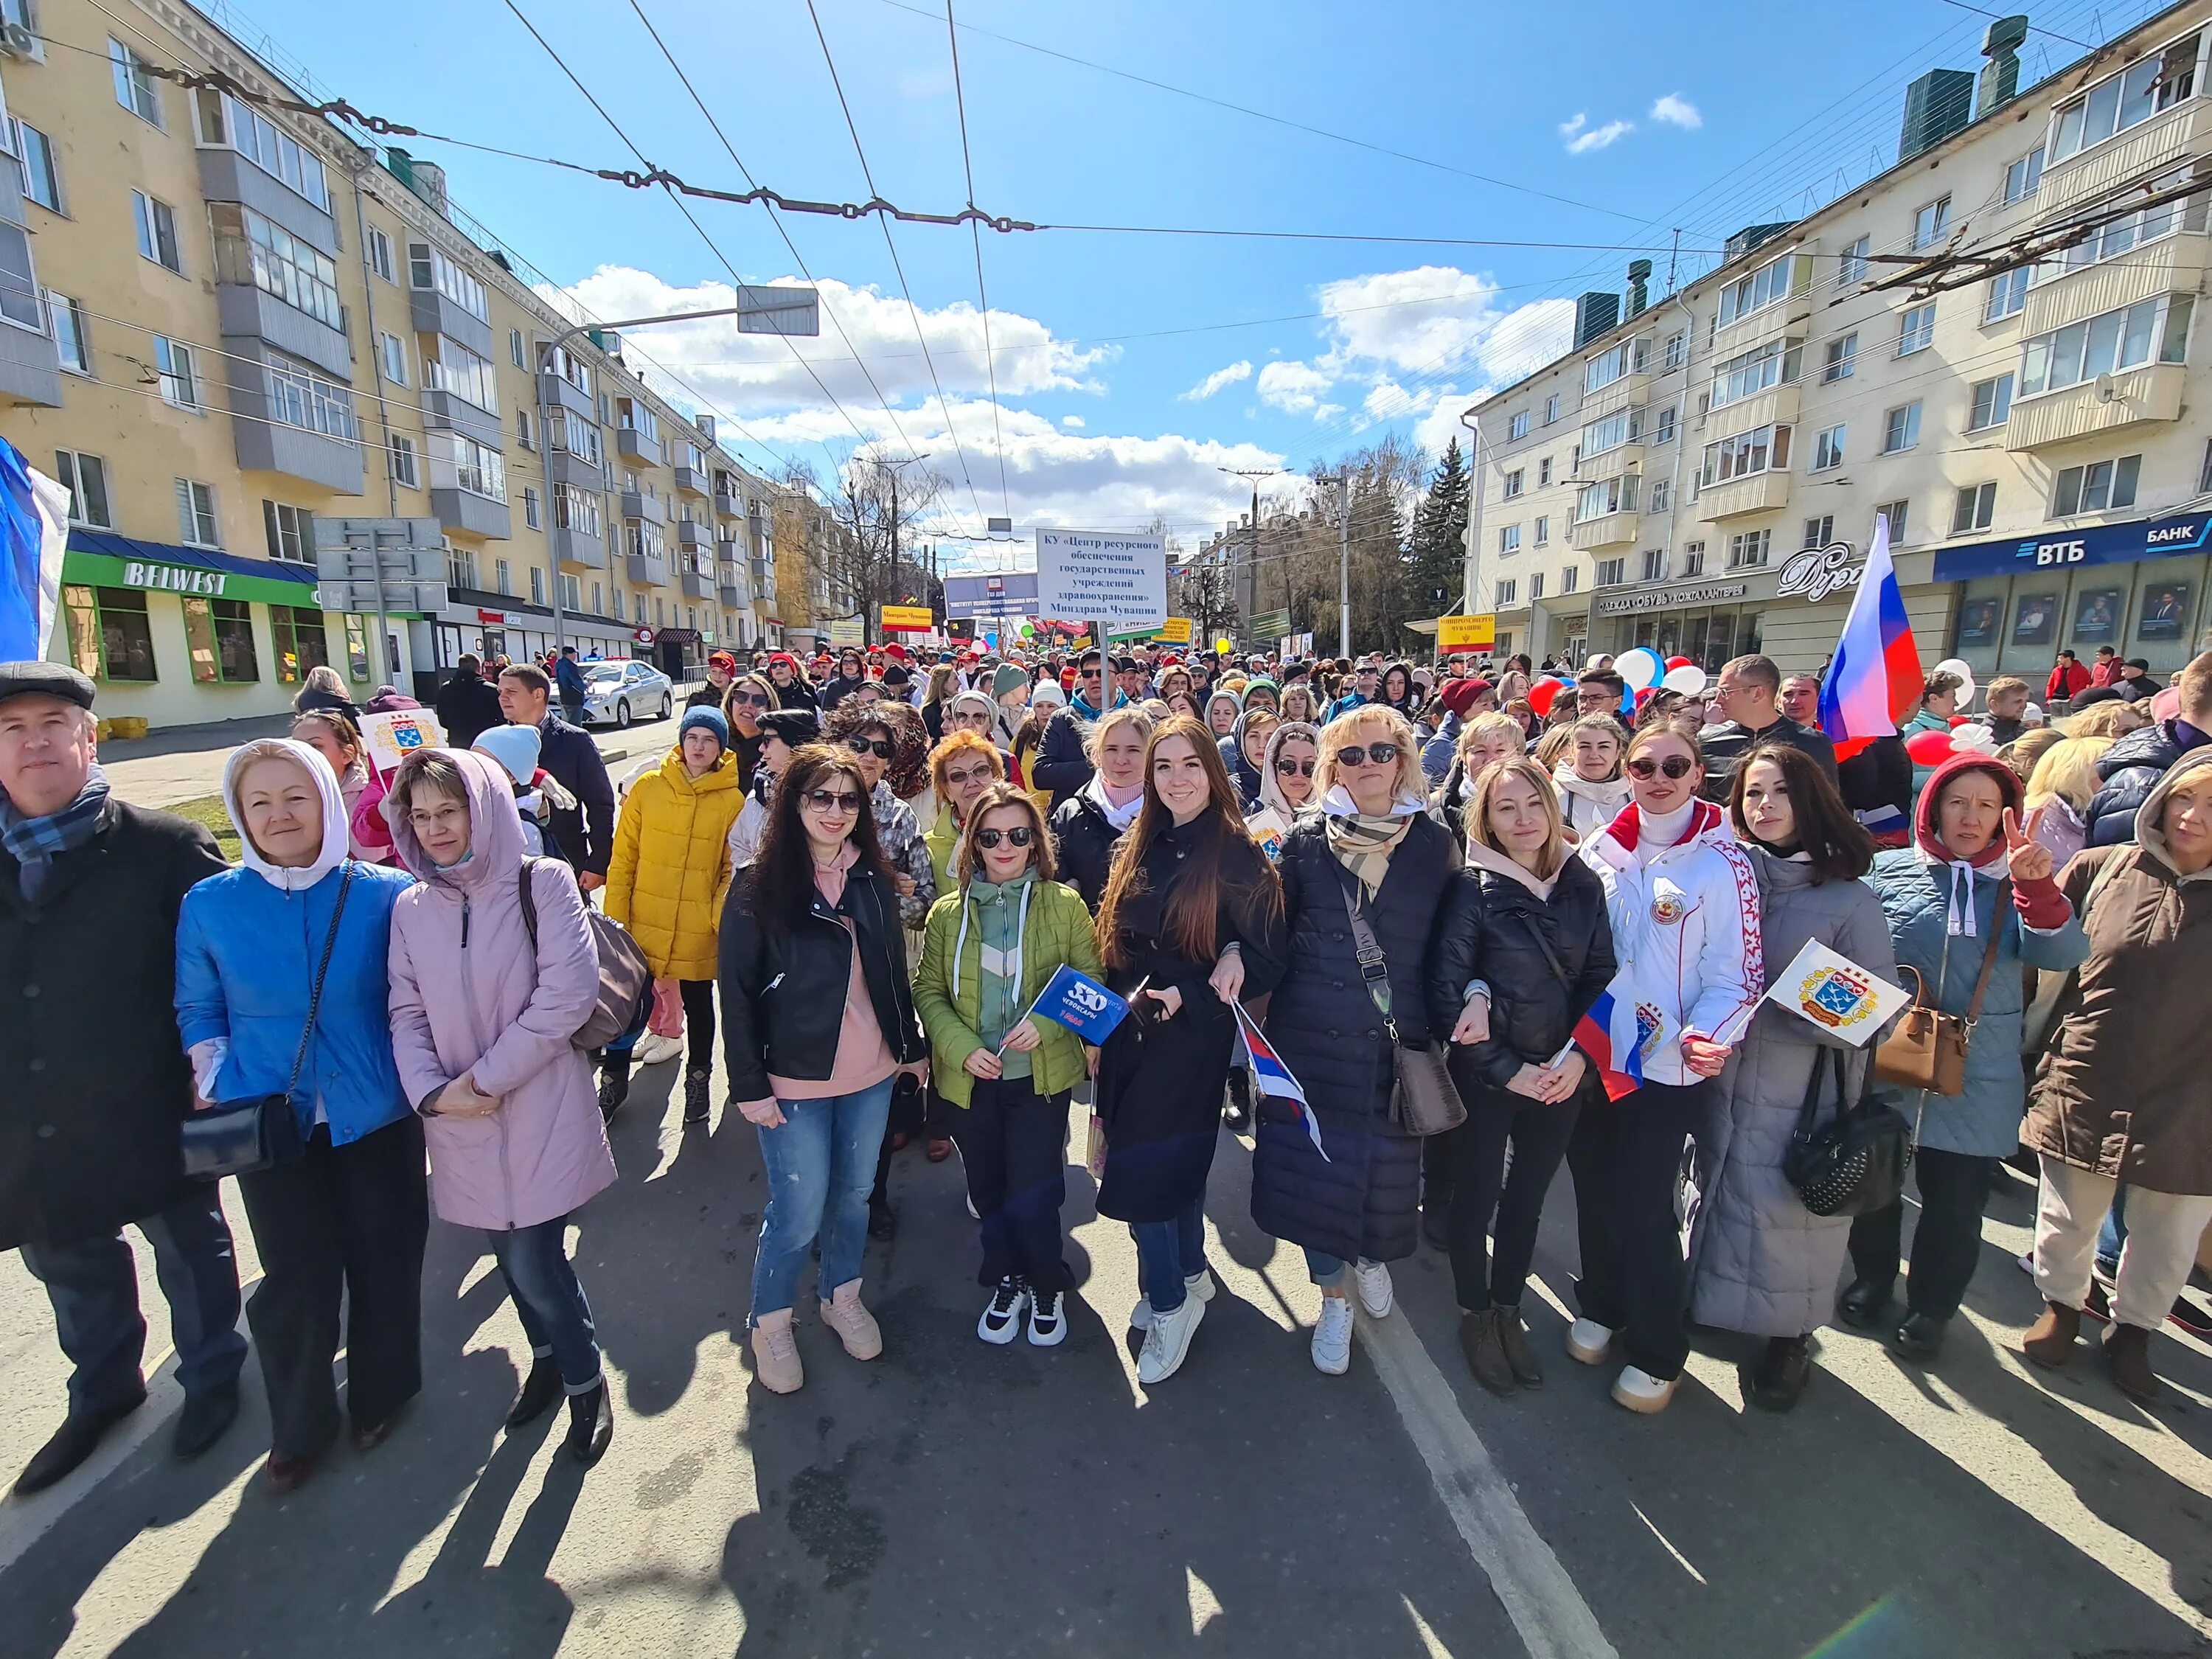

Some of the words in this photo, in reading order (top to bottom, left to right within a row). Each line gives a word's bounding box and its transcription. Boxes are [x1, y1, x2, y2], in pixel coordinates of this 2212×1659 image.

[2146, 525, 2194, 543] БАНК
[1044, 535, 1060, 544] КУ
[1063, 536, 1101, 549] «Центр
[1105, 539, 1159, 551] ресурсного
[1071, 551, 1133, 562] обеспечения
[2037, 540, 2085, 566] ВТБ
[1060, 565, 1145, 575] государственных
[123, 562, 228, 595] BELWEST
[1072, 579, 1133, 588] учреждений
[1057, 591, 1150, 602] здравоохранения»
[1599, 600, 1632, 612] ОДЕЖДА
[1637, 594, 1668, 608] ОБУВЬ
[1673, 585, 1745, 603] КОЖГАЛАНТЕРЕЯ
[1051, 603, 1107, 614] Минздрава
[1110, 605, 1157, 616] Чувашии
[1062, 996, 1097, 1020] ЧЕБОКСАРЫ
